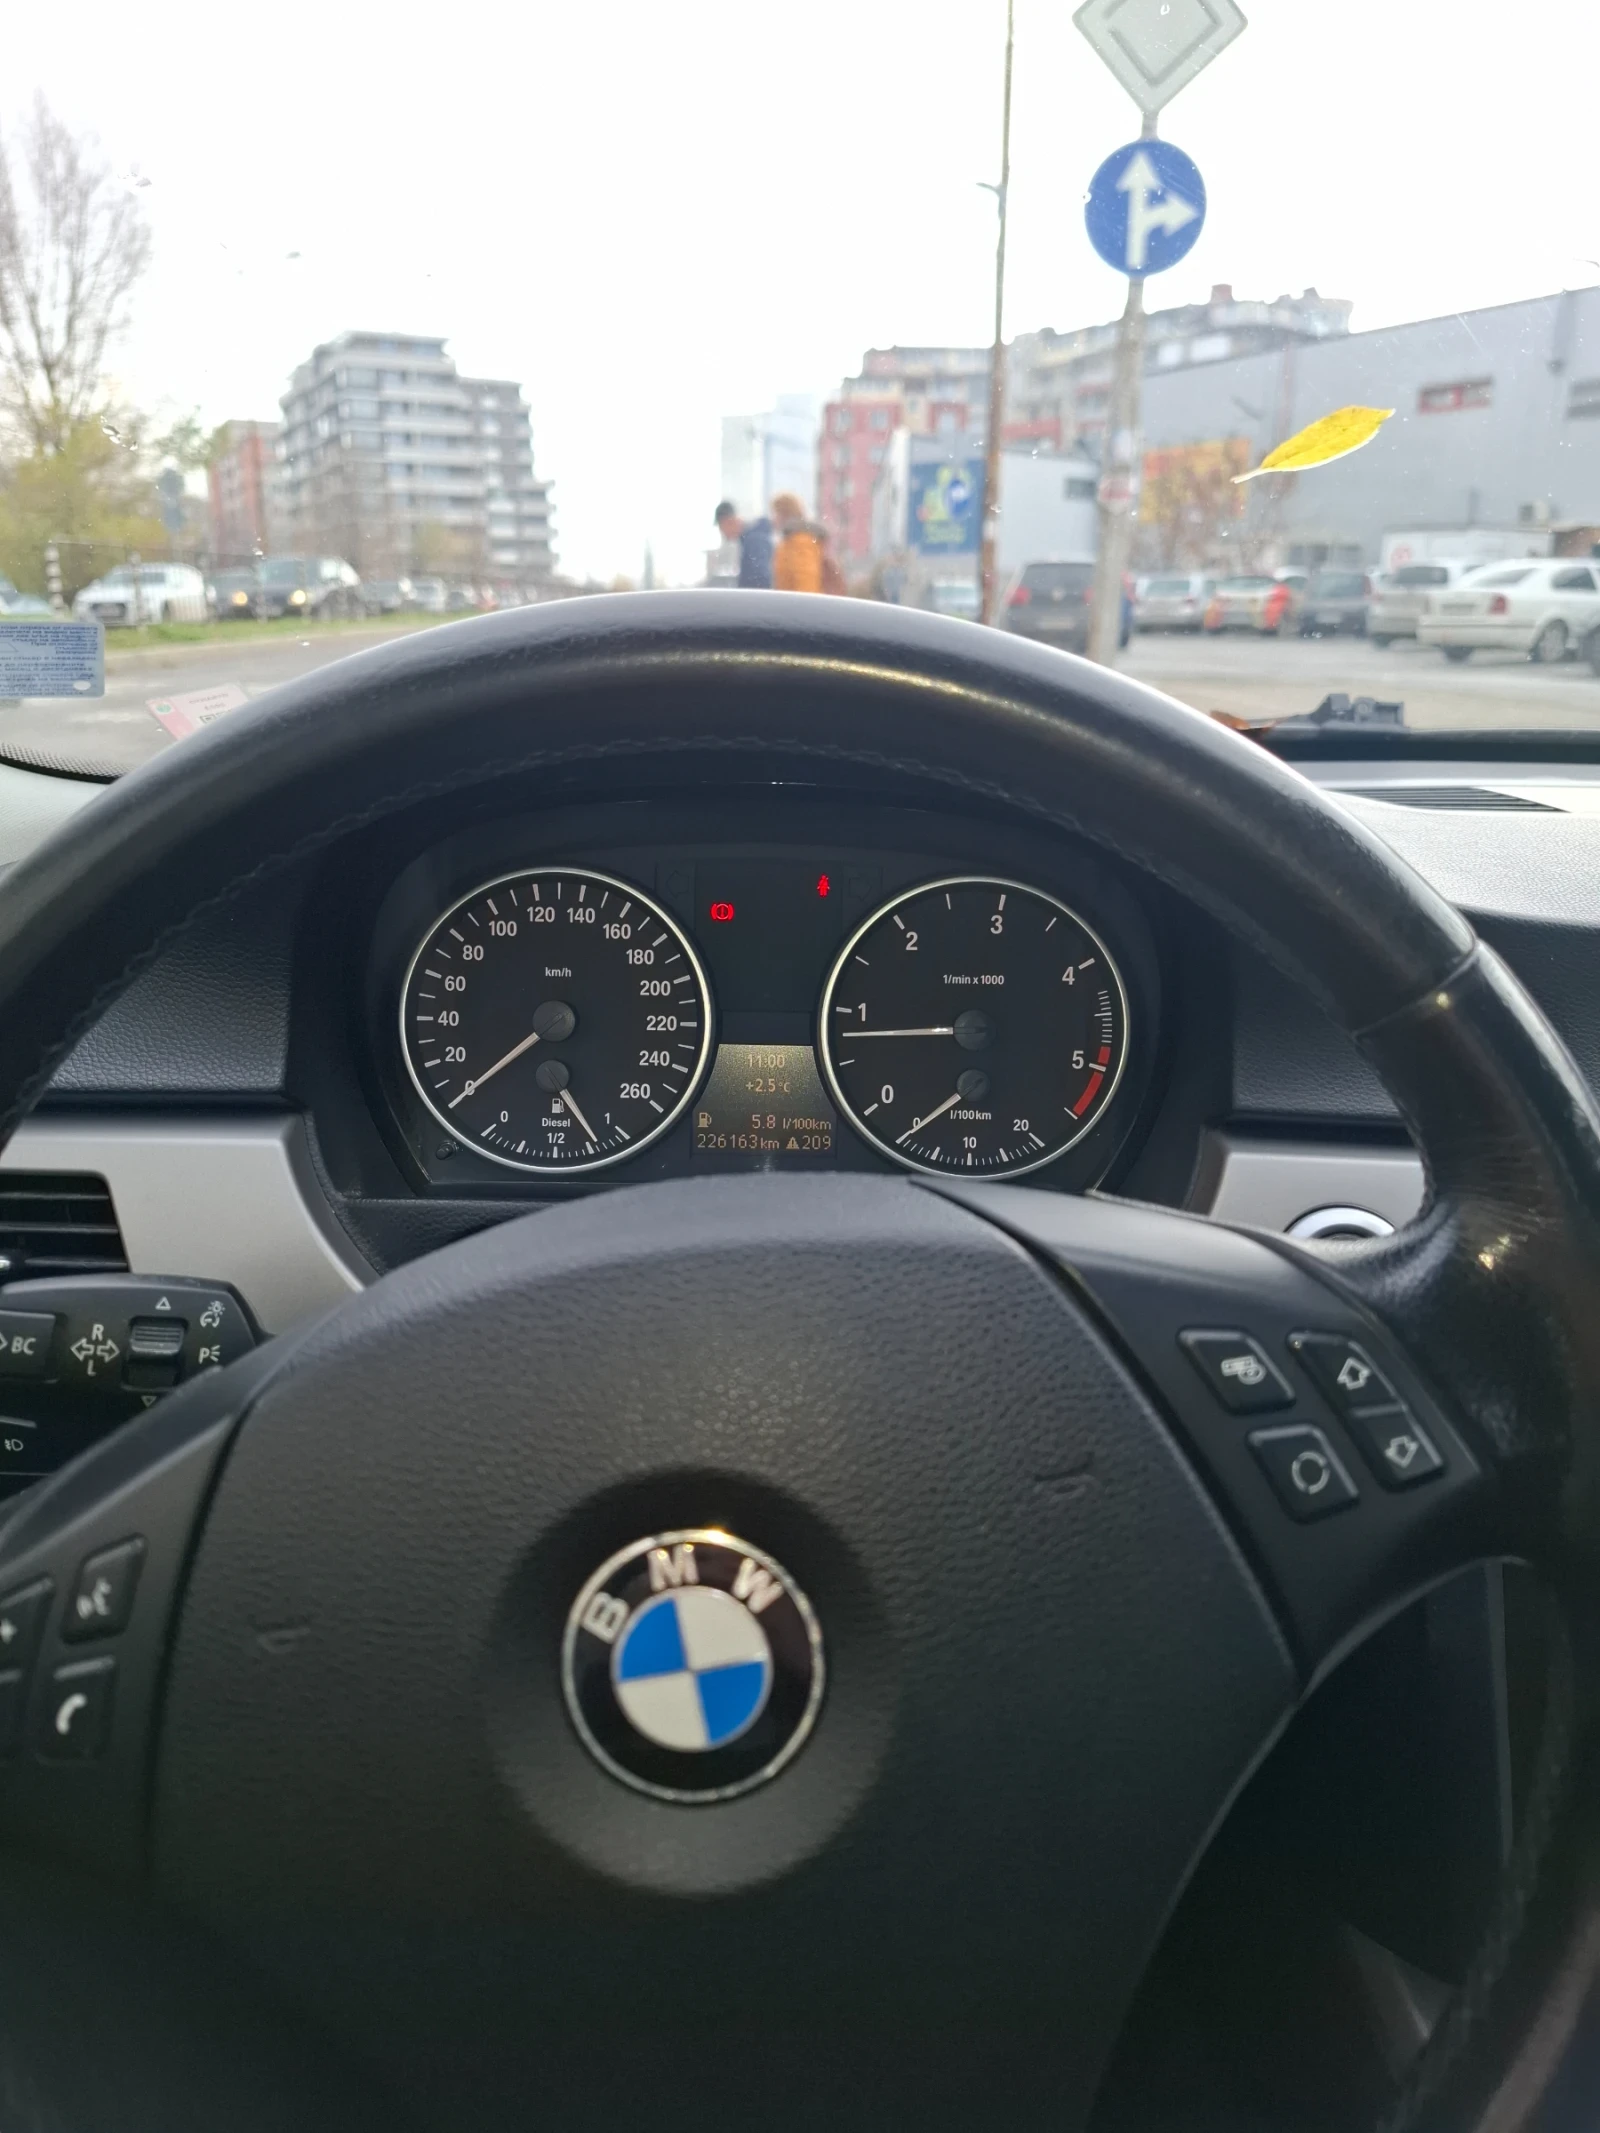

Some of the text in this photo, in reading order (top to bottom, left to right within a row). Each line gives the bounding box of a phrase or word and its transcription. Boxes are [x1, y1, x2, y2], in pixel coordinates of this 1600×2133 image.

[527, 907, 556, 923] 120
[567, 908, 596, 924] 140
[489, 921, 518, 937] 100
[603, 923, 632, 940] 160
[990, 914, 1003, 934] 3
[905, 932, 918, 951] 2
[462, 945, 485, 961] 80
[626, 949, 655, 965] 180
[545, 967, 572, 978] km/h
[943, 974, 971, 986] 1/min
[980, 974, 1004, 986] 1000
[1061, 967, 1075, 985] 4
[444, 976, 467, 991] 60
[640, 980, 671, 996] 200
[437, 1011, 460, 1027] 40
[857, 1004, 867, 1021] 1
[646, 1015, 677, 1031] 220
[444, 1046, 467, 1062] 20
[639, 1050, 671, 1067] 240
[747, 1054, 785, 1069] 11:00
[1071, 1050, 1085, 1069] 5
[465, 1080, 476, 1096] 0
[619, 1083, 651, 1099] 260
[881, 1085, 894, 1103] 0
[500, 1110, 509, 1123] 0
[541, 1118, 571, 1128] Diesel
[604, 1113, 612, 1125] 1
[752, 1114, 776, 1129] 5.8
[1013, 1119, 1029, 1132] 20
[547, 1132, 566, 1144] 1/2
[801, 1135, 831, 1150] 209
[963, 1137, 977, 1149] 10
[92, 1323, 104, 1341] R
[11, 1337, 36, 1355] BC
[199, 1347, 210, 1363] P
[87, 1360, 96, 1375] L
[581, 1542, 784, 1645] BMW
